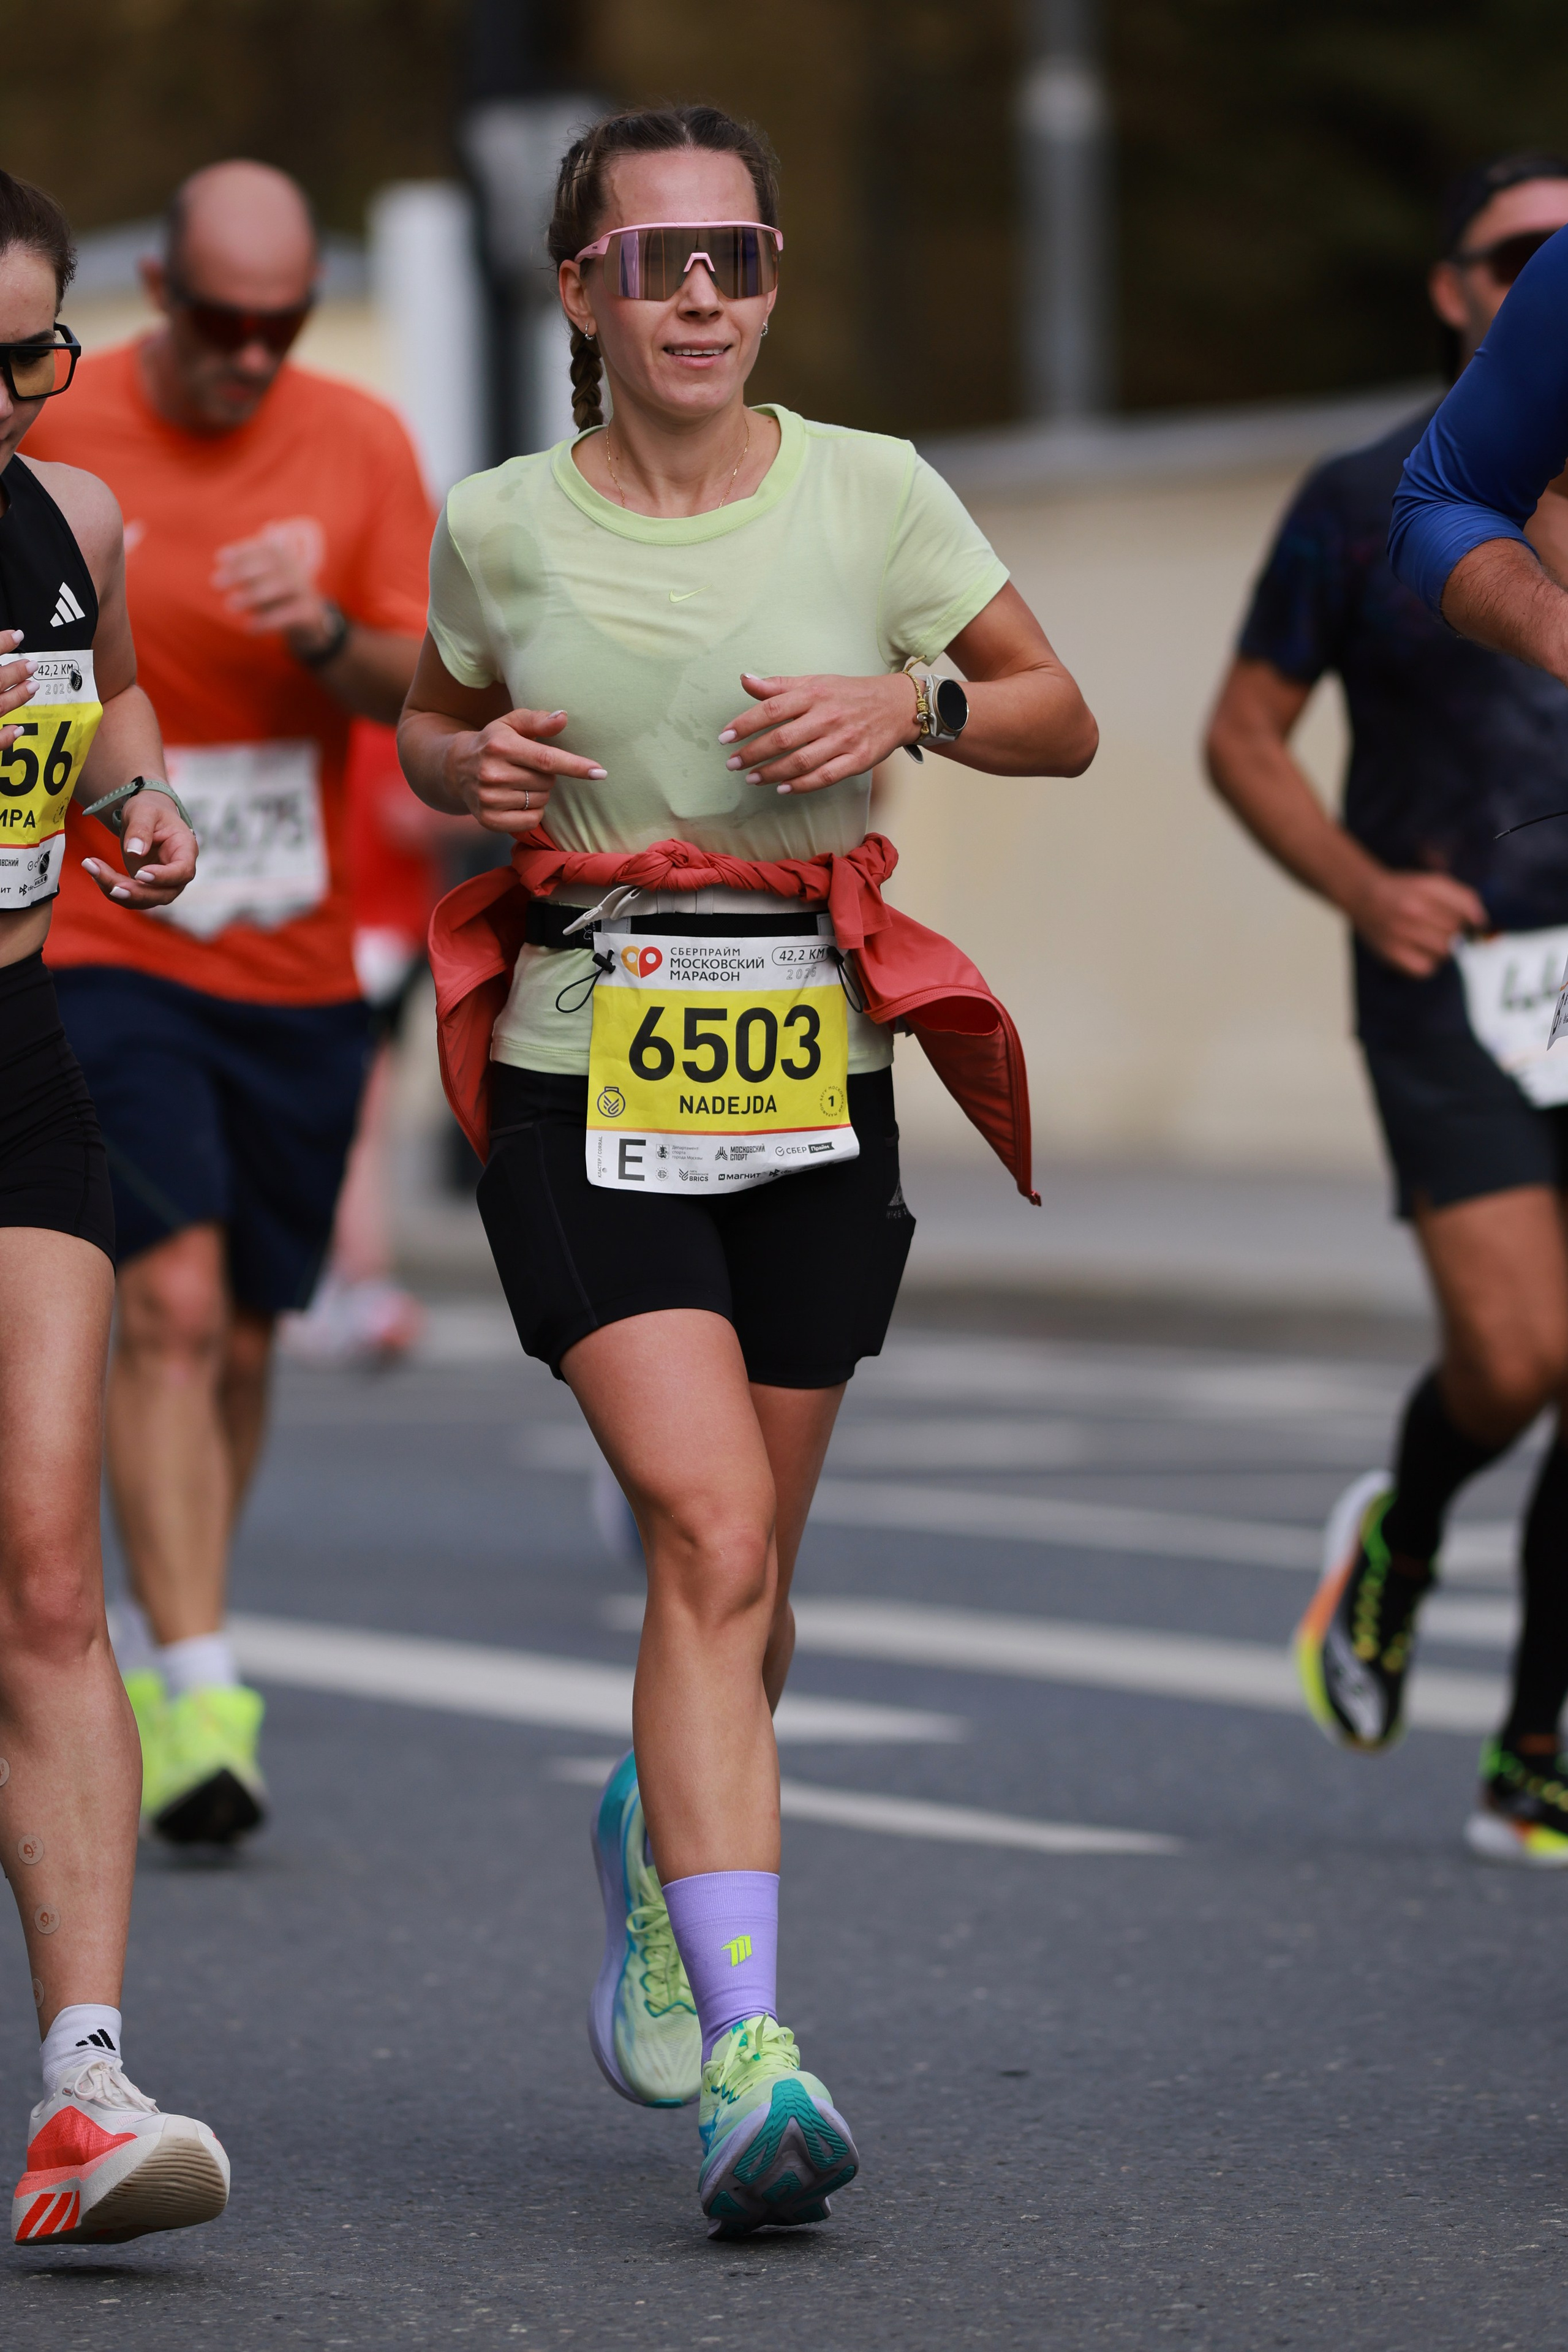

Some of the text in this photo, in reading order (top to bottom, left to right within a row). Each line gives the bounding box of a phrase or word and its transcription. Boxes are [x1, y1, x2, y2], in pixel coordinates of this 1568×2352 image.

[38, 664, 58, 677] 42,2
[45, 683, 72, 695] 2026
[670, 946, 741, 956] СБЕРПРАЙМ
[778, 949, 805, 962] 42,2
[670, 957, 764, 969] МОСКОВСКИЙ
[670, 970, 740, 981] МАРАФОН
[786, 966, 817, 980] 2026
[628, 1004, 821, 1083] 6503
[679, 1095, 777, 1114] NADEJDA
[827, 1095, 834, 1107] 1
[730, 1144, 766, 1153] МОСКОВСКИЙ
[618, 1138, 646, 1182] E
